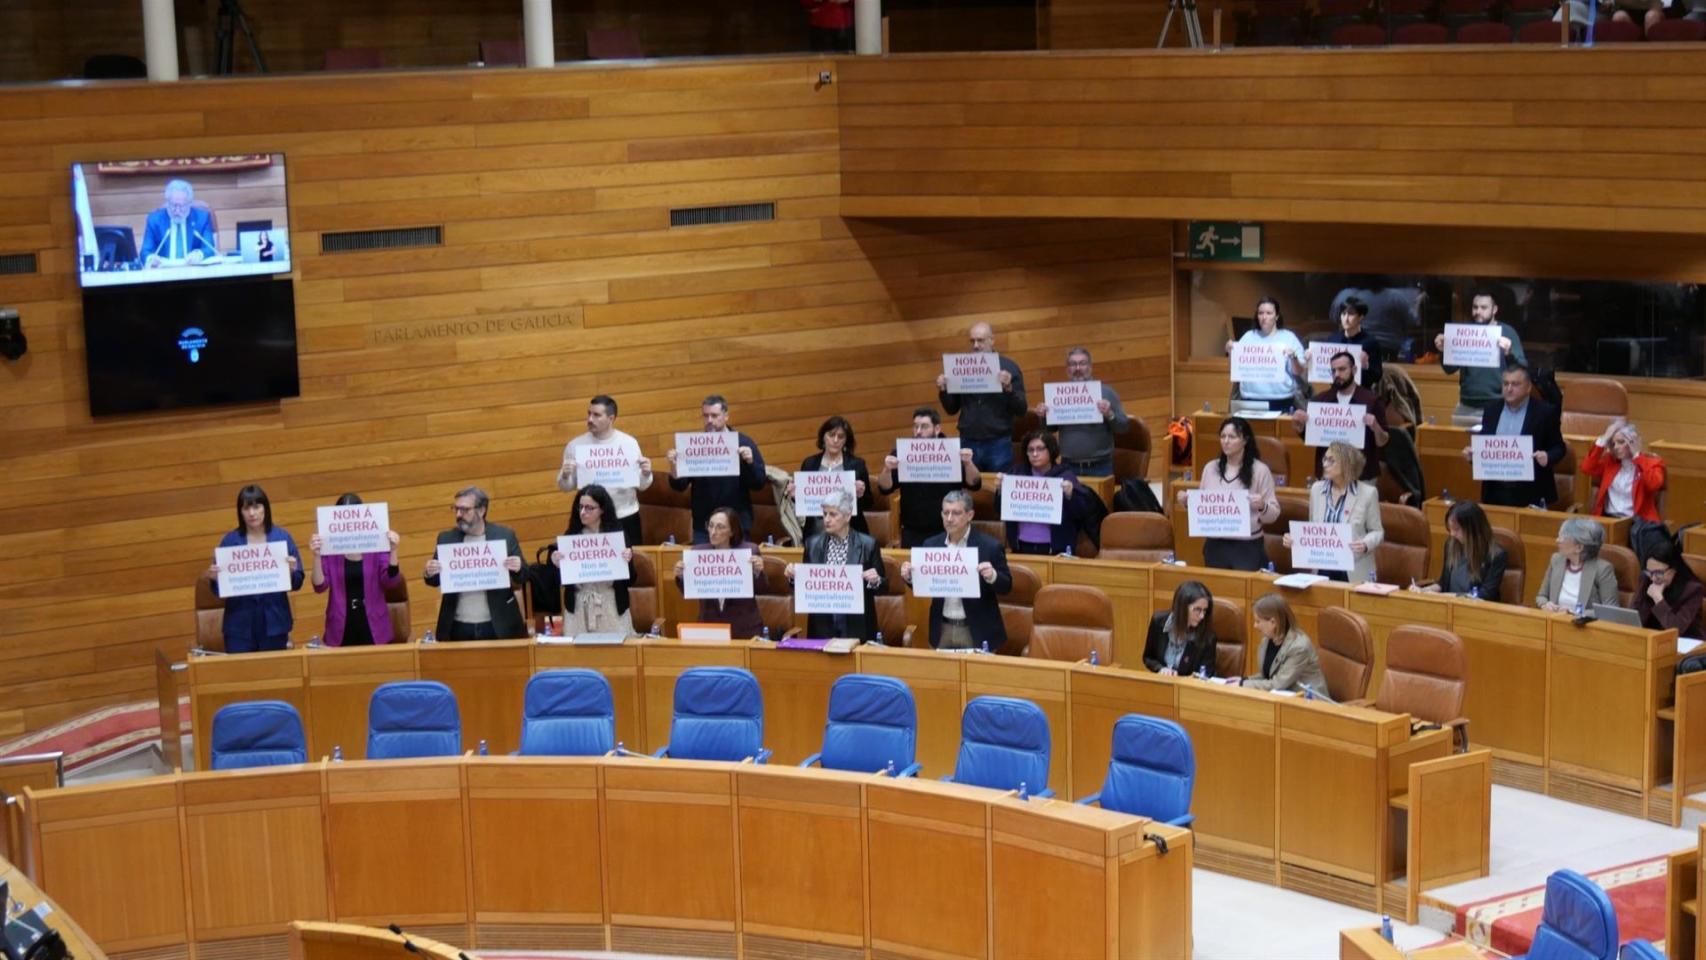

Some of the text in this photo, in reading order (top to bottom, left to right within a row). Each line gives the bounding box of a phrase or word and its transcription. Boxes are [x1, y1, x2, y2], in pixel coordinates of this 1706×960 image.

[374, 312, 572, 344] PARLAMENTO DE GALICIA
[1452, 339, 1491, 348] GUERRA
[953, 367, 992, 376] GUERRA
[1053, 397, 1093, 406] GUERRA
[1315, 419, 1356, 428] GUERRA
[690, 436, 714, 445] NON
[590, 449, 614, 457] NON
[686, 446, 730, 456] GUERRA
[907, 454, 950, 463] GUERRA
[1481, 452, 1523, 460] GUERRA
[585, 458, 629, 469] GUERRA
[808, 476, 831, 484] NON
[1016, 480, 1039, 489] NON
[1011, 492, 1053, 502] GUERRA
[1201, 495, 1225, 503] NON
[334, 510, 362, 520] NON
[1197, 506, 1240, 516] GUERRA
[329, 521, 378, 533] GUERRA
[1303, 527, 1327, 536] NON
[573, 538, 598, 549] NON
[1300, 538, 1343, 548] GUERRA
[232, 550, 260, 560] NON
[453, 547, 479, 557] NON
[569, 549, 616, 562] GUERRA
[925, 552, 951, 561] NON
[698, 555, 725, 564] NON
[228, 560, 278, 573] GUERRA
[450, 559, 497, 571] GUERRA
[694, 566, 742, 576] GUERRA
[810, 569, 835, 578] NON
[920, 566, 968, 575] GUERRA
[805, 582, 853, 591] GUERRA
